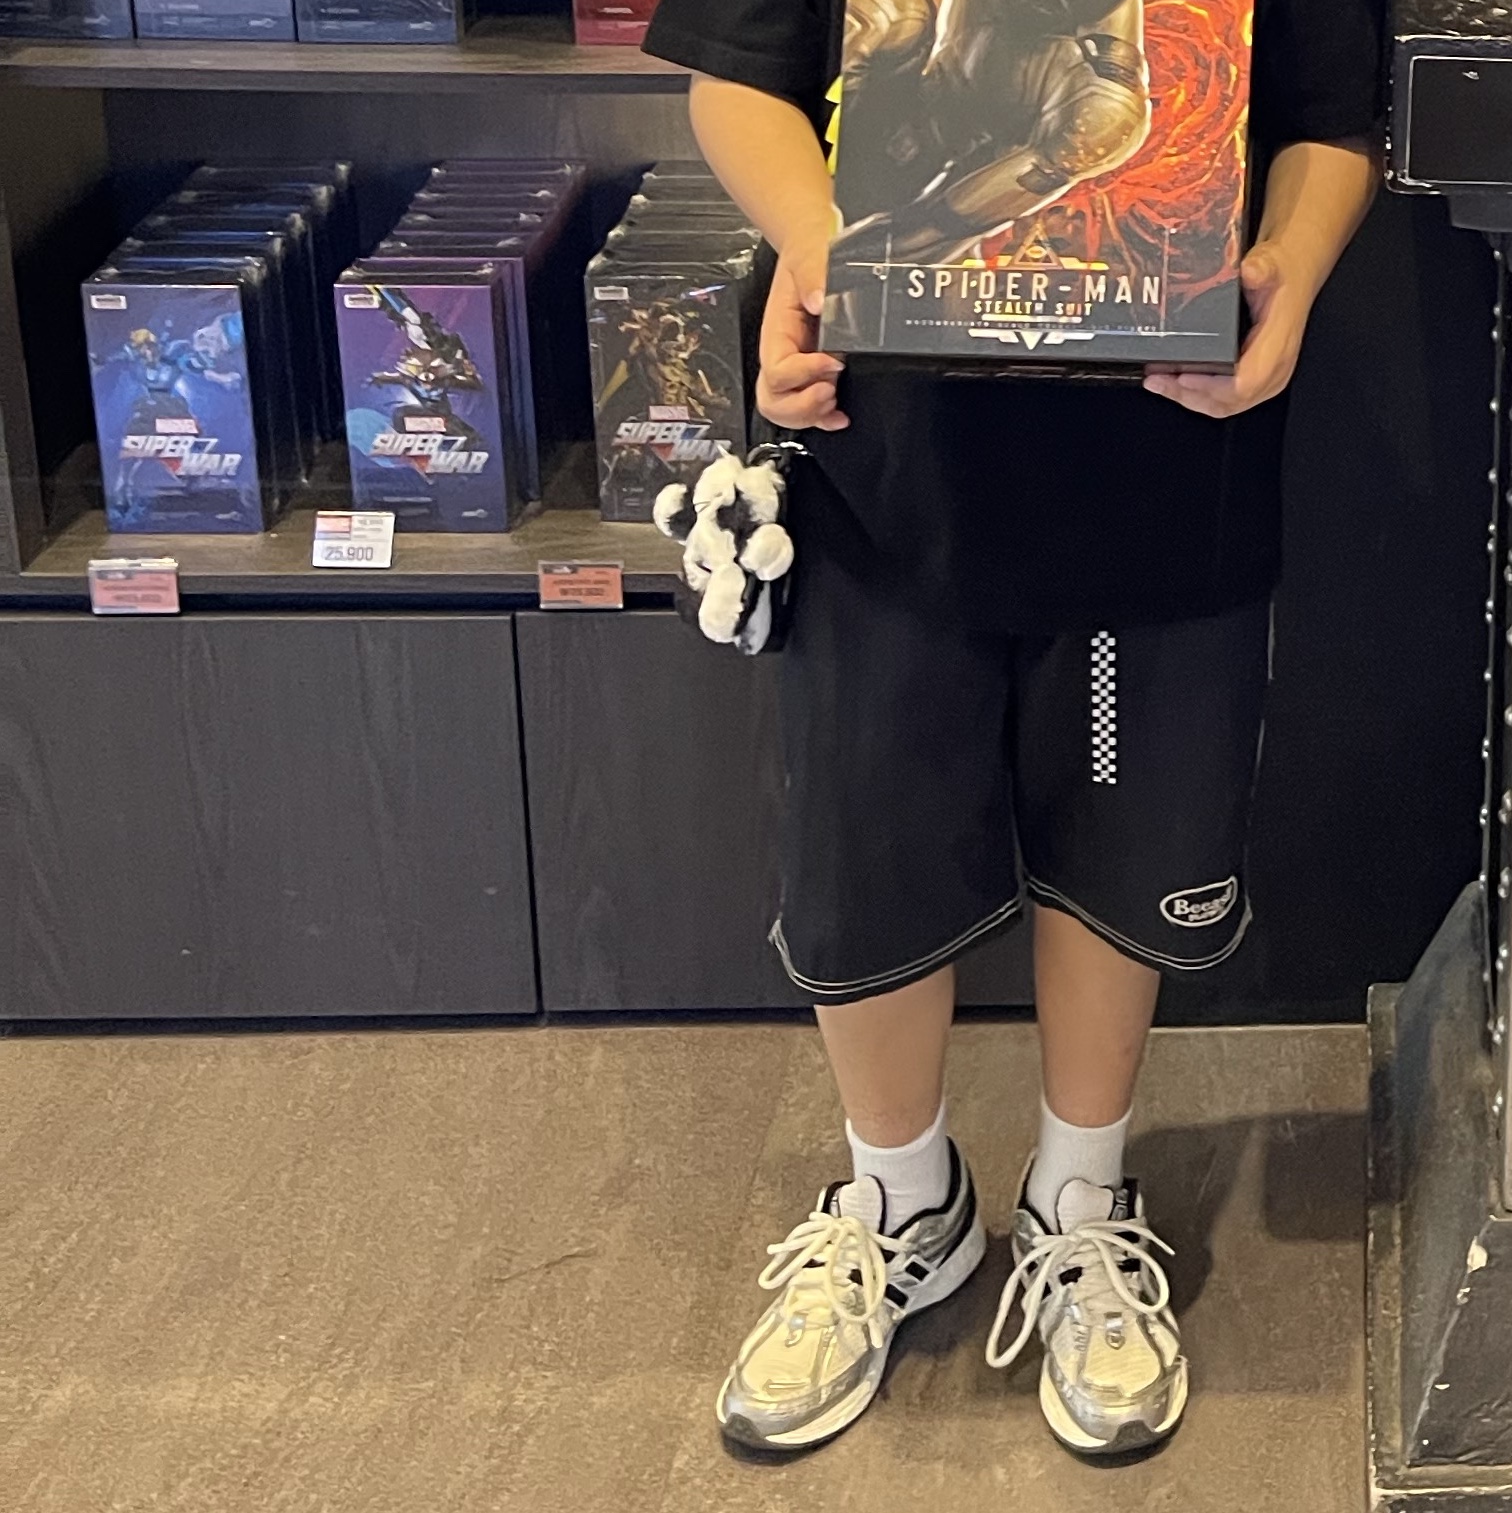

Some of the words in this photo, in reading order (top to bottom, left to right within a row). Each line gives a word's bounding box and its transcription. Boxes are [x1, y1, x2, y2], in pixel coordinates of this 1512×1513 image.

[907, 269, 1160, 304] SPIDER-MAN
[974, 301, 1043, 314] STEALTH
[1055, 302, 1092, 316] SUIT
[369, 433, 438, 456] SUPER
[612, 422, 682, 446] SUPER
[120, 435, 192, 458] SUPER
[176, 454, 243, 476] WAR
[426, 451, 489, 474] WAR
